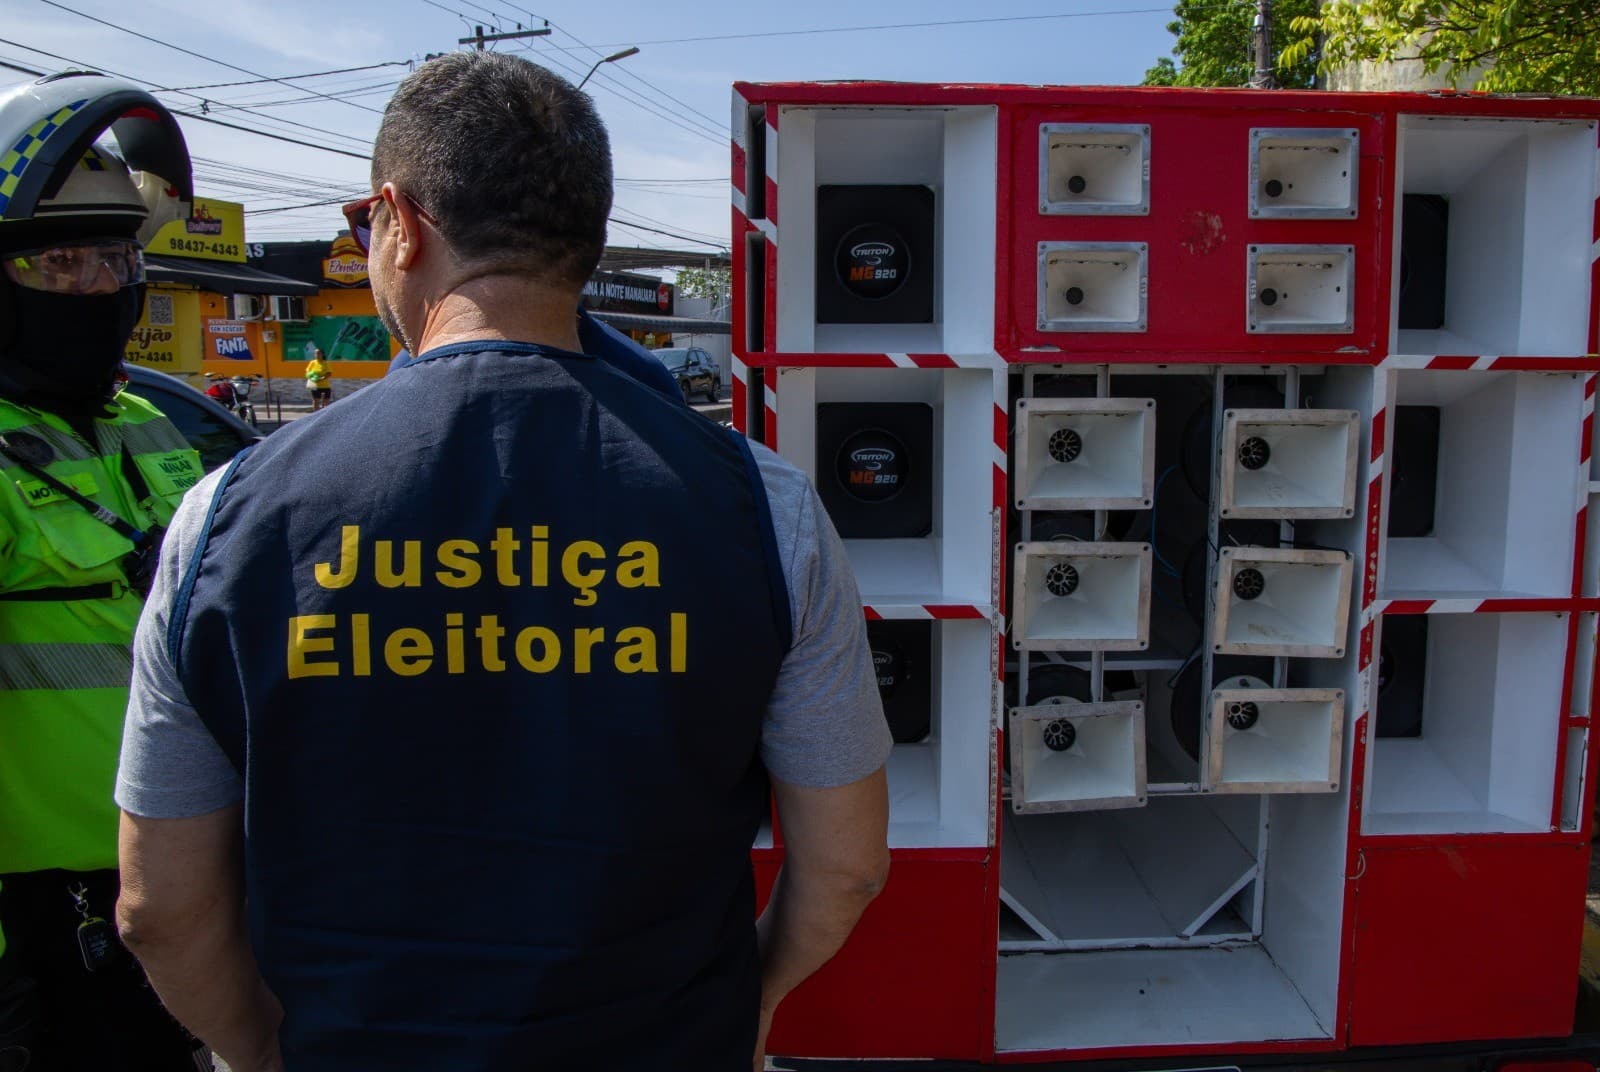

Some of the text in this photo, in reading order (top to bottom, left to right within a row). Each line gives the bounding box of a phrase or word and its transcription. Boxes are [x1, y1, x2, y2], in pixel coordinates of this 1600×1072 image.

[170, 238, 239, 257] 98437-4343
[856, 248, 889, 256] TRITON
[605, 283, 625, 300] NOITE
[130, 327, 172, 350] eijão
[215, 336, 249, 355] FANTA
[856, 453, 890, 461] TRITON
[314, 524, 661, 607] Justiça
[287, 612, 688, 680] Eleitoral
